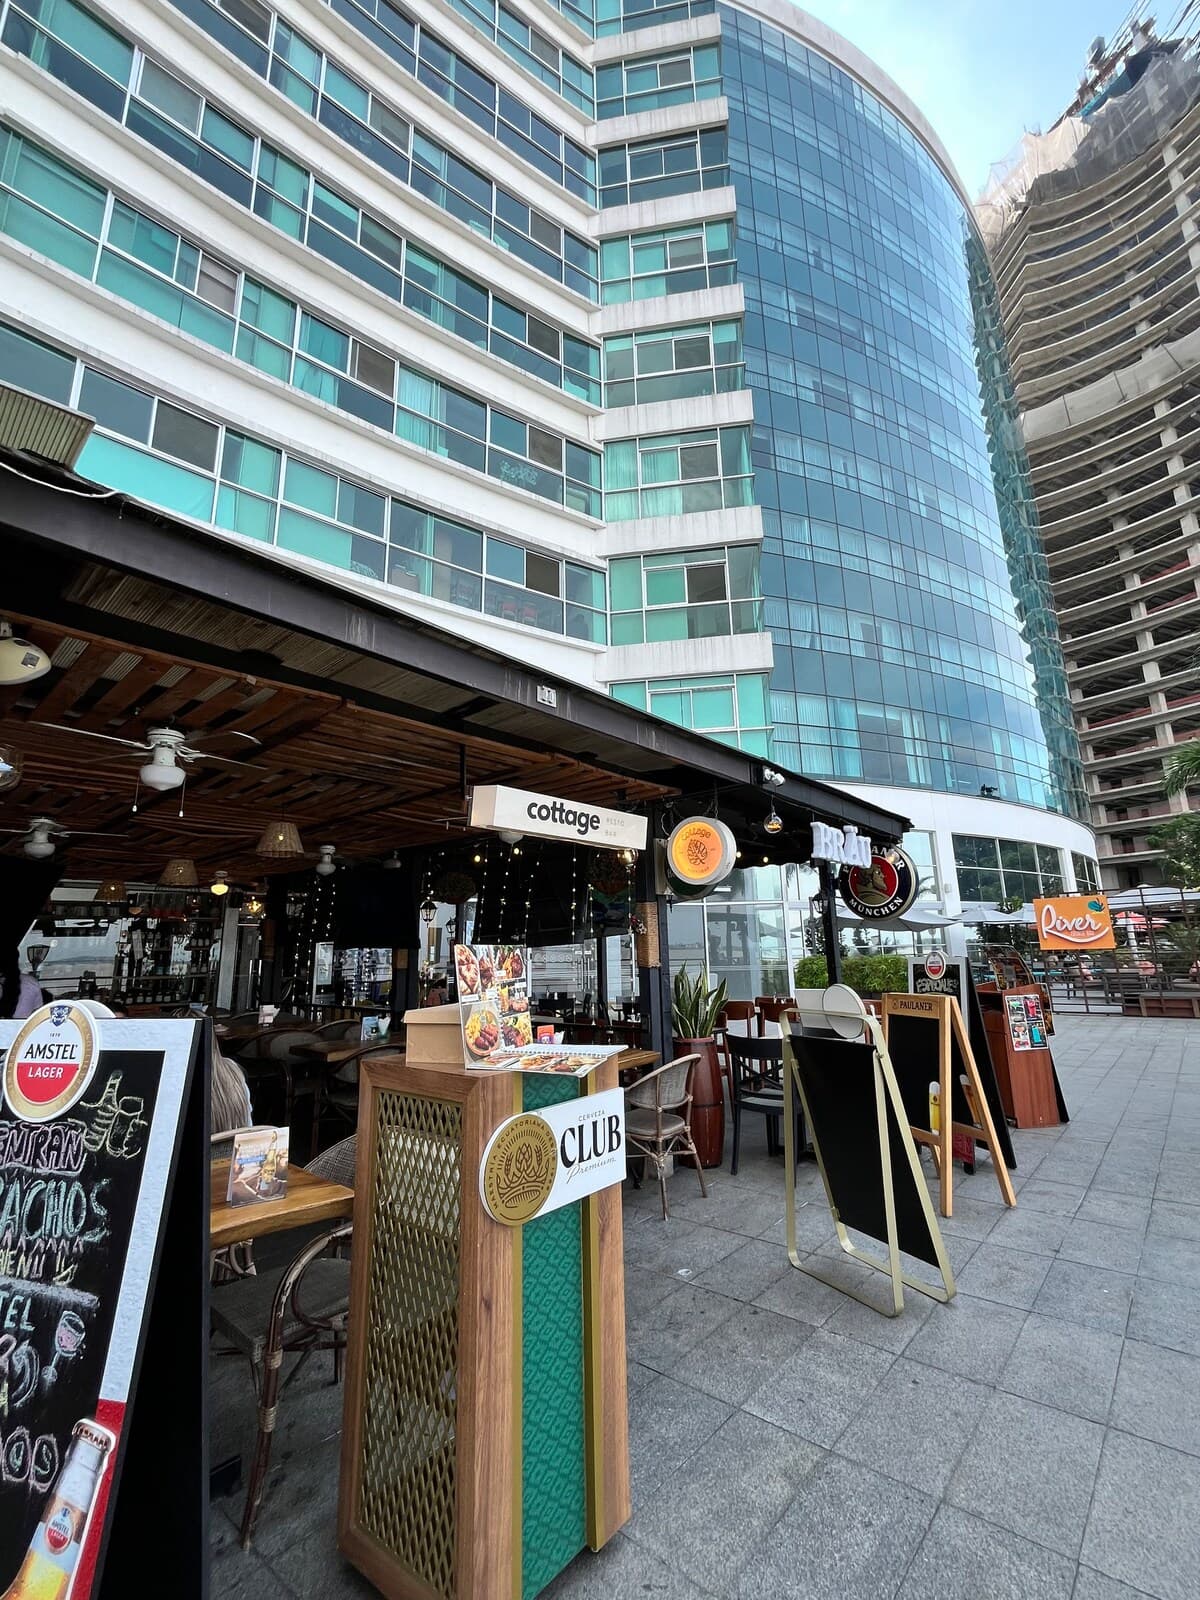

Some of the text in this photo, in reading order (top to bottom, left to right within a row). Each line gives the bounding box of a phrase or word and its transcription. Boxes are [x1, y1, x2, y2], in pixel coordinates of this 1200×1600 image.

[527, 801, 600, 835] cottage
[843, 845, 905, 873] PANR
[849, 896, 903, 916] MÜNCHEN
[1041, 904, 1109, 943] River
[900, 1000, 933, 1011] PAULANER
[24, 1043, 76, 1060] AMSTEL
[28, 1066, 64, 1078] LAGER
[578, 1109, 605, 1121] CERVEZA
[560, 1114, 621, 1168] CLUB
[566, 1157, 616, 1184] Premium
[0, 1177, 109, 1242] ACHOS
